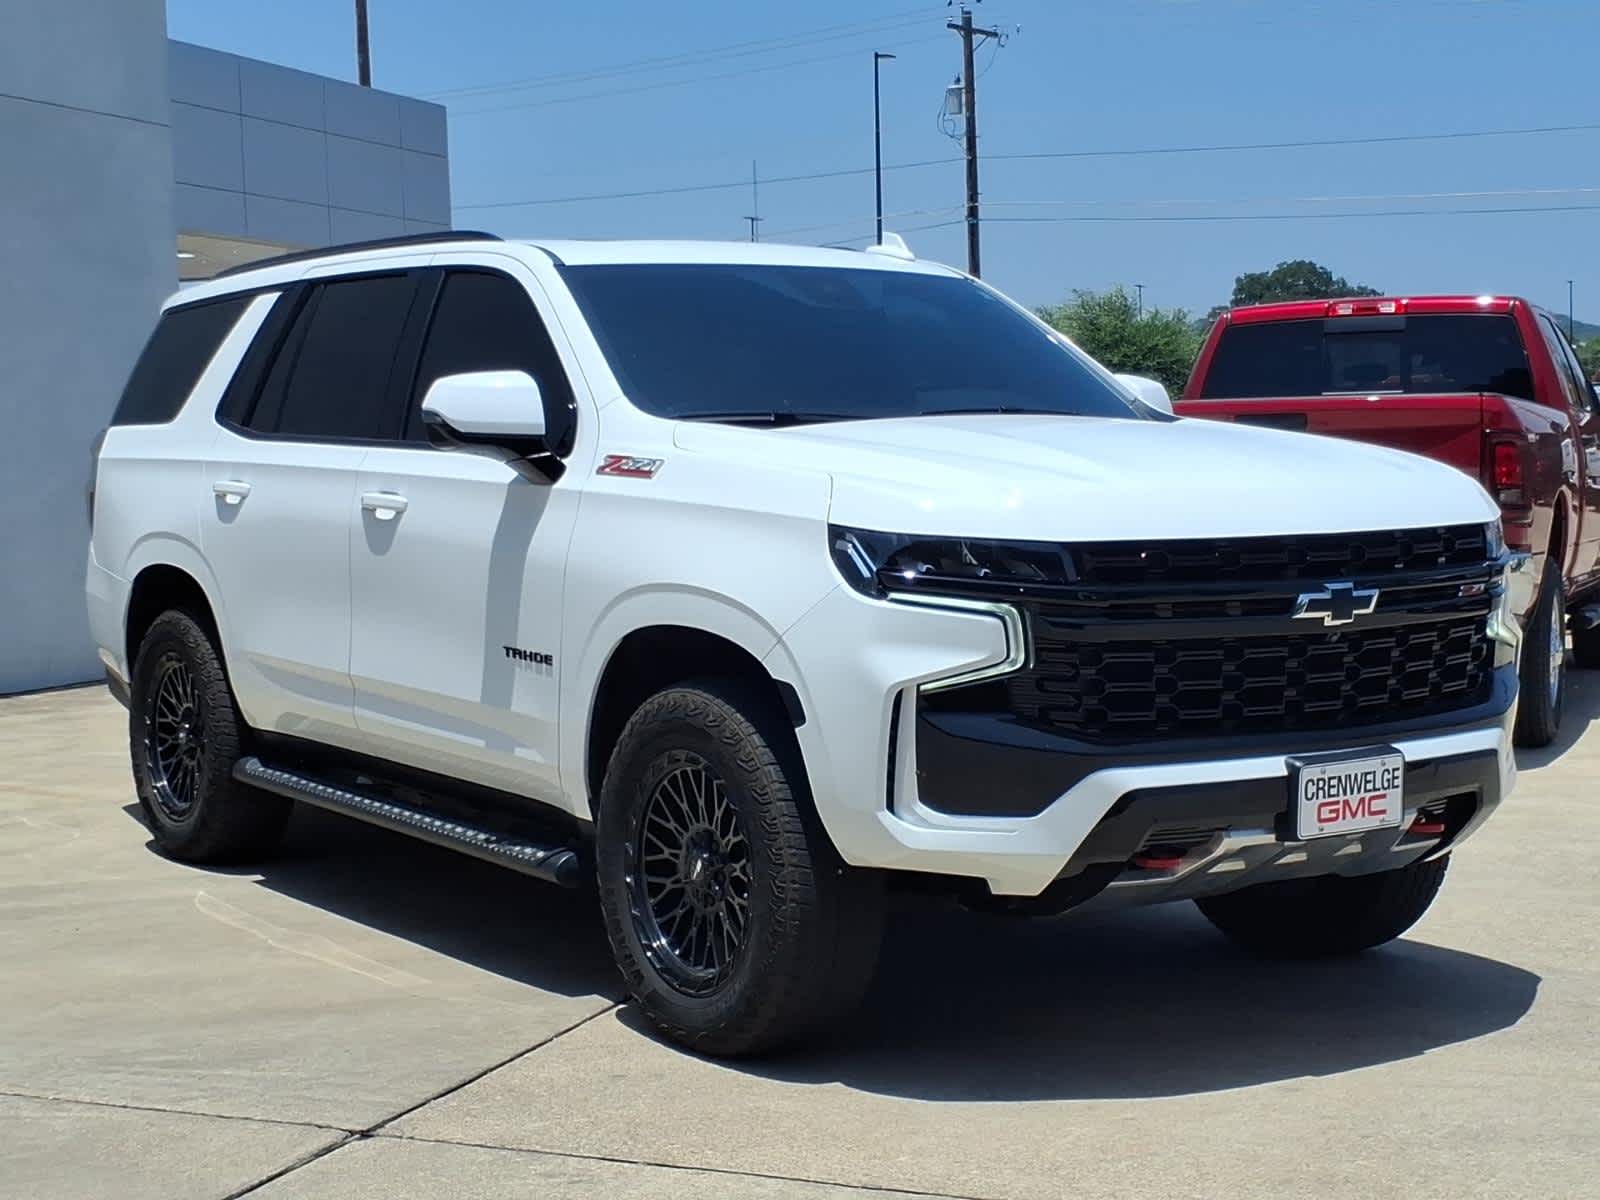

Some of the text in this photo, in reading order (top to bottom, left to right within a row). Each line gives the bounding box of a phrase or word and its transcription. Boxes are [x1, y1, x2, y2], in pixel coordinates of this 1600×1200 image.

[502, 646, 553, 667] TAHOE
[1304, 767, 1400, 802] CRENWELGE
[1317, 793, 1387, 824] GMC
